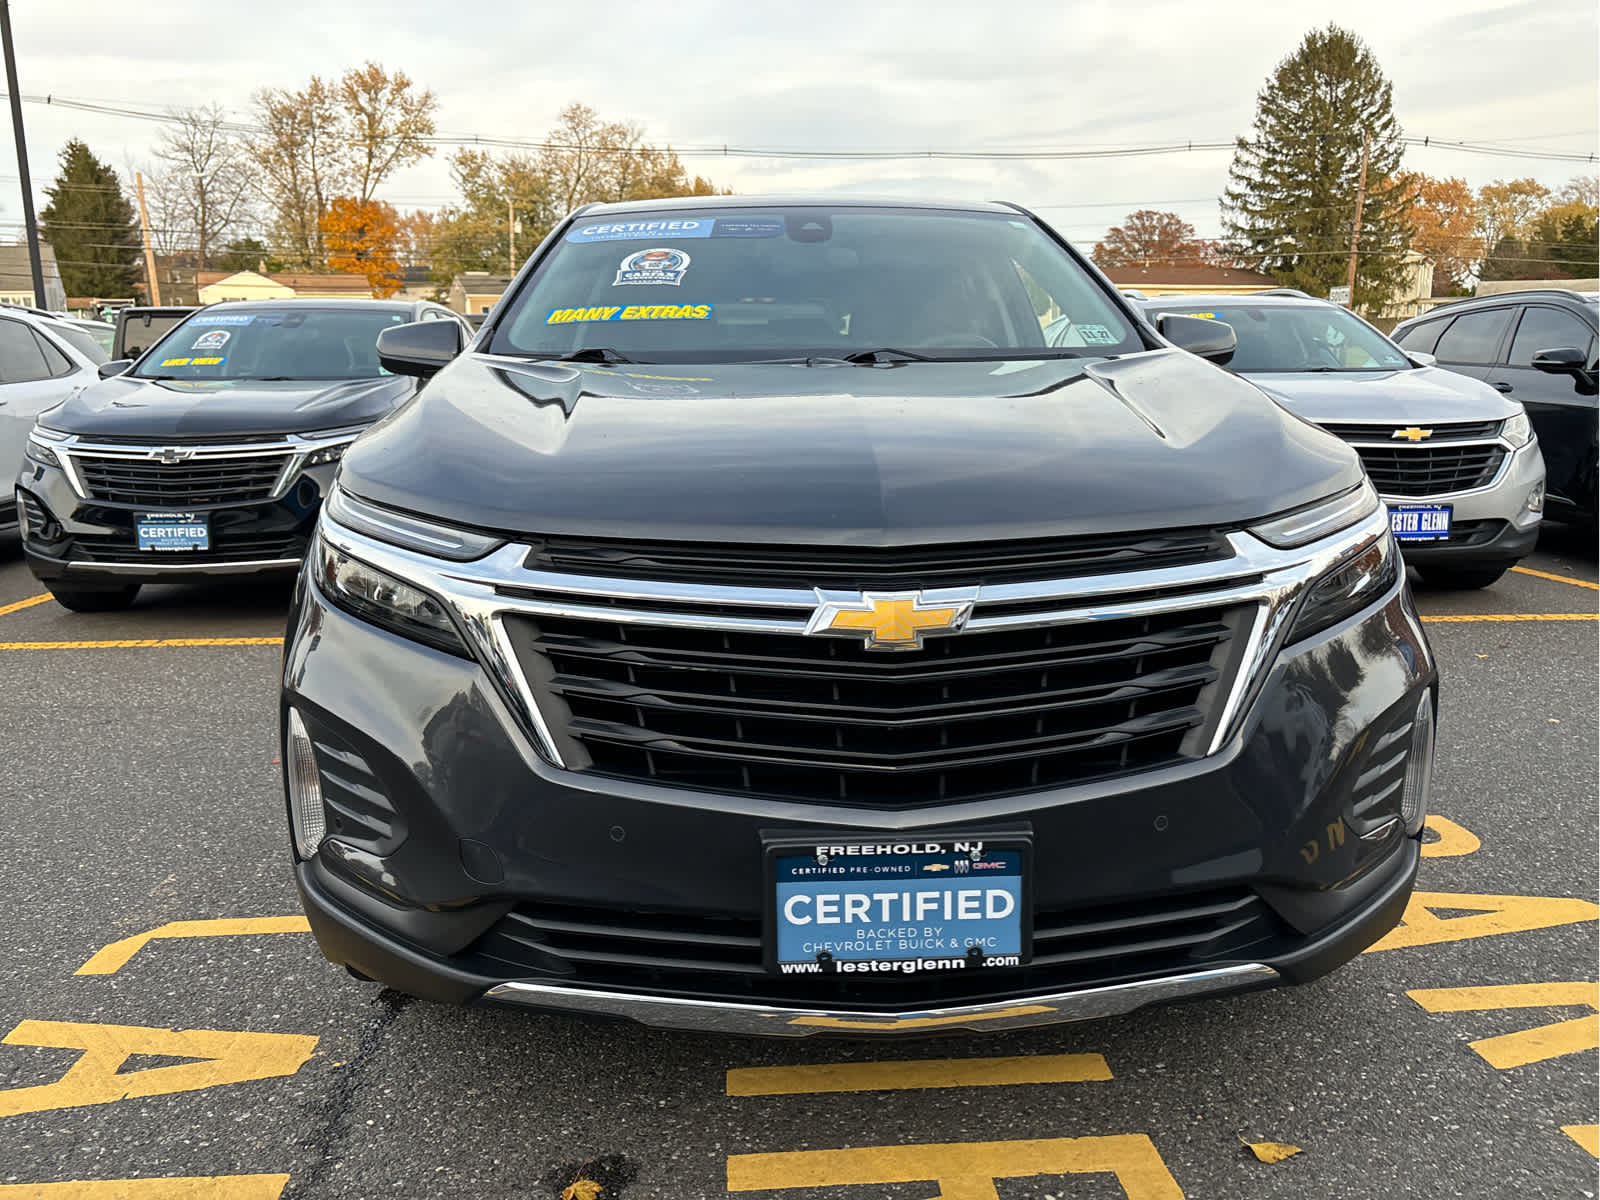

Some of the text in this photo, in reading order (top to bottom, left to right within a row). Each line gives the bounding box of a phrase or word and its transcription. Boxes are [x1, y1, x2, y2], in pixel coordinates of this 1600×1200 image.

[583, 221, 699, 235] CERTIFIED
[547, 305, 711, 324] MANY EXTRAS
[1391, 511, 1449, 532] ESTER GLENN
[140, 527, 207, 538] CERTIFIED
[816, 841, 983, 856] FREEHOLD, NJ
[791, 865, 911, 875] CERTIFIED PRE-OWNED
[972, 861, 1006, 869] GMC
[783, 889, 1015, 925] CERTIFIED
[856, 927, 943, 940] BACKED BY
[802, 936, 998, 953] CHEVROLET BUICK & GMC
